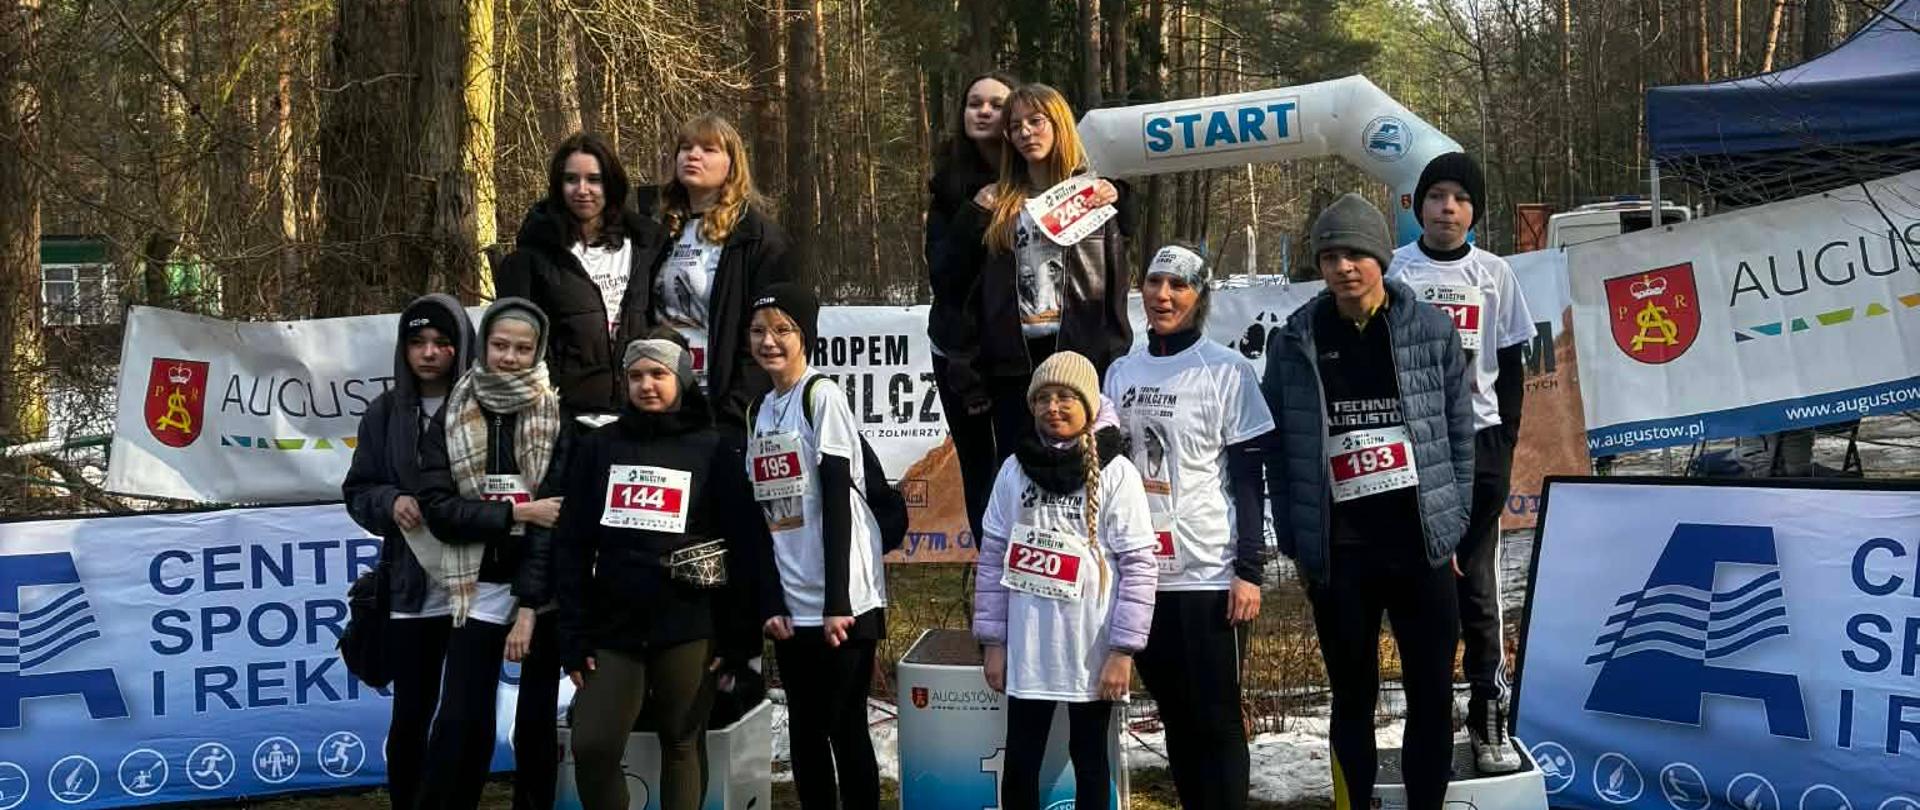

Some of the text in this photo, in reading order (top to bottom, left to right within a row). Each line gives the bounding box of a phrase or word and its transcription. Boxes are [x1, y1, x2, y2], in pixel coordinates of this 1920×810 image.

[1146, 102, 1295, 152] START
[761, 455, 791, 478] 195
[1347, 446, 1396, 475] 193
[621, 486, 666, 508] 144
[1016, 548, 1061, 576] 220
[150, 598, 349, 655] SPOR
[153, 670, 166, 716] I
[1837, 690, 1854, 748] I
